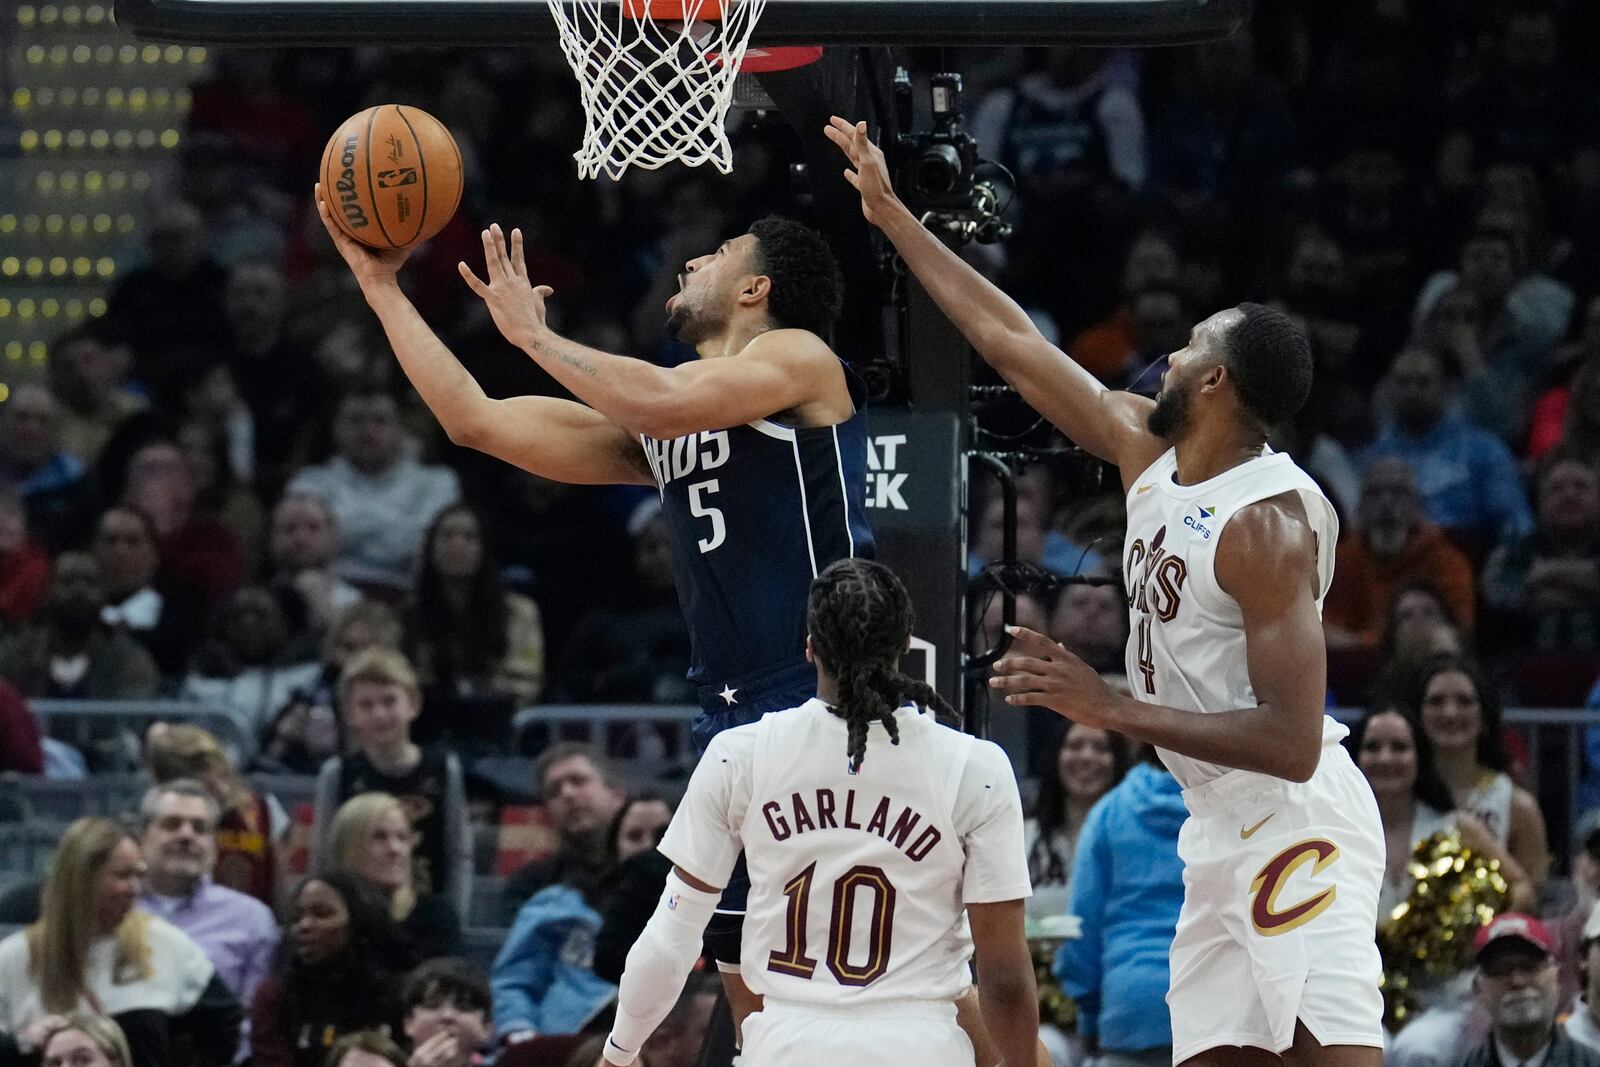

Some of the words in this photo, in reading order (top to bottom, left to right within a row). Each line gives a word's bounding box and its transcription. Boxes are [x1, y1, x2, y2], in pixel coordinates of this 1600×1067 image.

[336, 134, 369, 229] Wilson
[687, 478, 727, 554] 5
[1138, 616, 1156, 695] 4
[762, 788, 942, 862] GARLAND
[767, 859, 897, 987] 10
